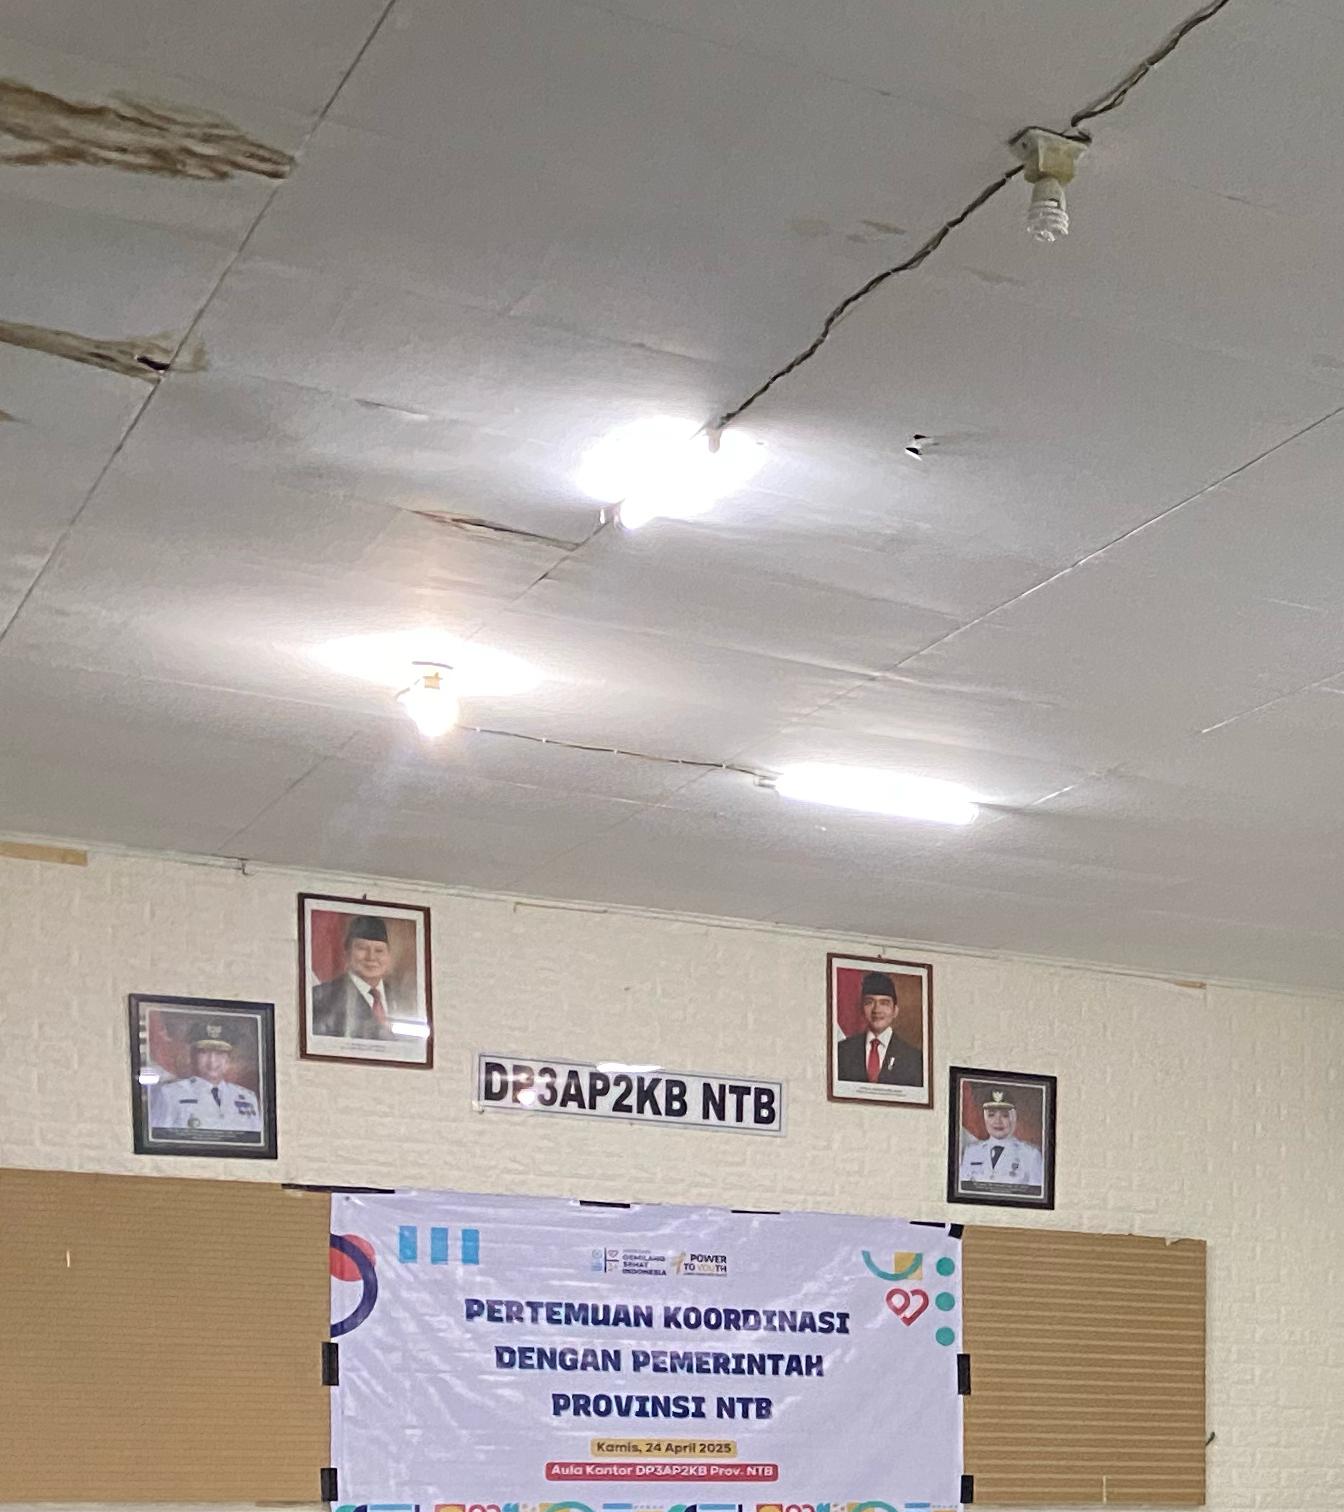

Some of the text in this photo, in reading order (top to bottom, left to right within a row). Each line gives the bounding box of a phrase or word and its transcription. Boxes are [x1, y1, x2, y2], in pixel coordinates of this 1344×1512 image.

[484, 1061, 776, 1125] DP3AP2KB NTB
[683, 1263, 695, 1271] TO
[690, 1253, 727, 1264] POWER
[464, 1298, 850, 1335] PERTEMUAN KOORDINASI
[494, 1345, 824, 1377] DENGAN PEMERINTAH
[551, 1393, 774, 1420] PROVINSI NTB
[596, 1442, 731, 1455] Kamis, 24 April 2025
[551, 1464, 773, 1476] Aula Kantor DP3AP2KB Prov. NTB
